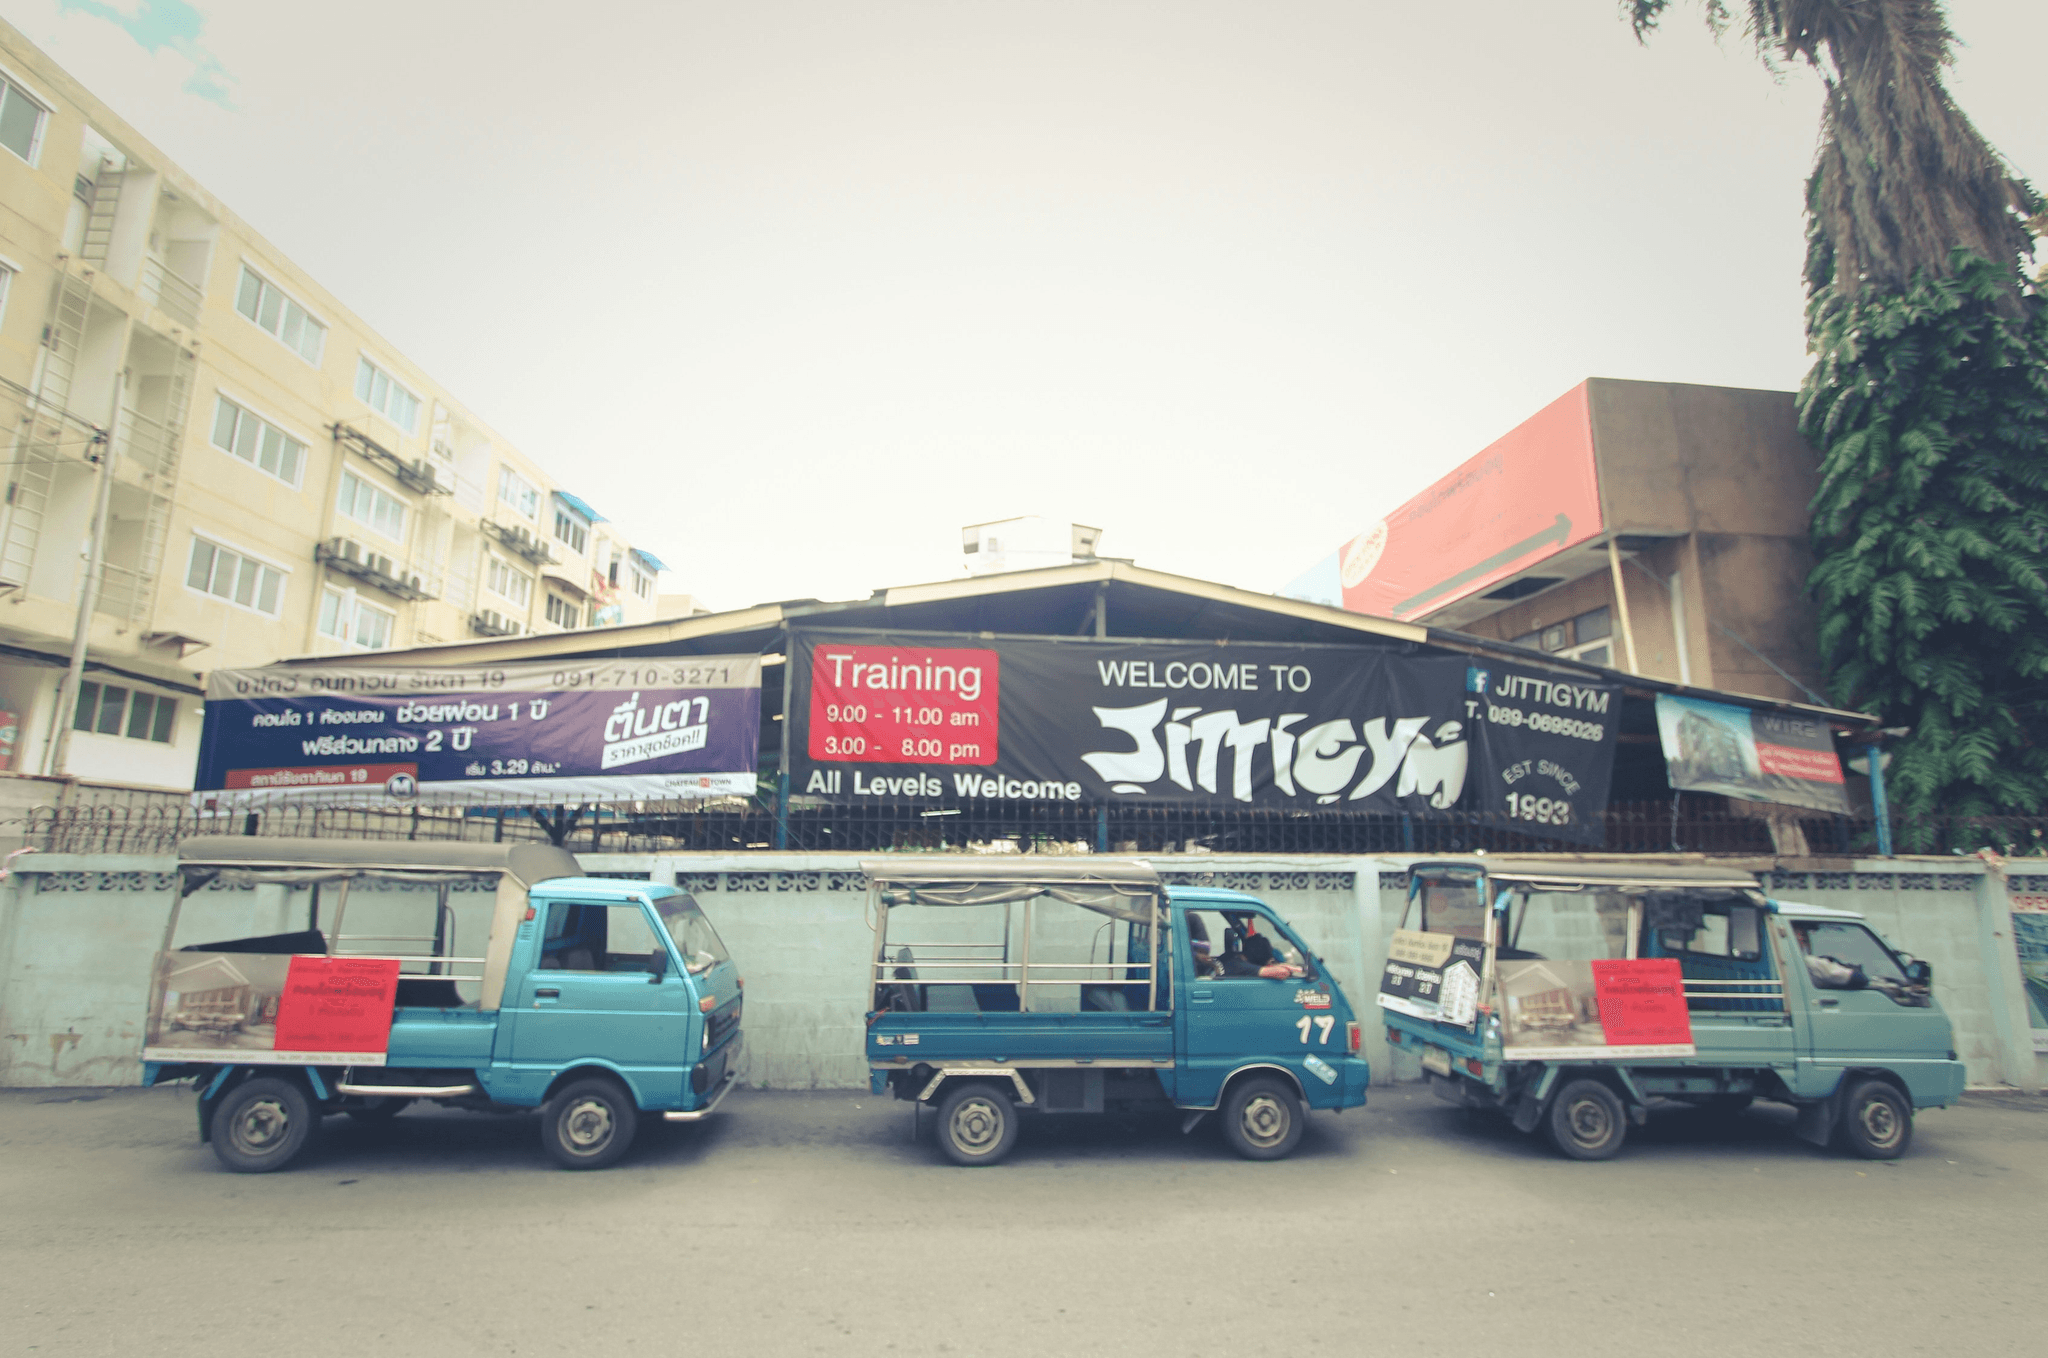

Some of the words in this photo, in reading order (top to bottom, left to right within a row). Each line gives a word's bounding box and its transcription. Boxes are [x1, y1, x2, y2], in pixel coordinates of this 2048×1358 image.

[479, 670, 505, 688] 19
[552, 668, 730, 686] 091-710-3271
[827, 653, 982, 700] Training
[1097, 659, 1259, 692] WELCOME
[1269, 665, 1312, 693] TO
[1495, 674, 1610, 714] JITTIGYM
[306, 711, 314, 726] 1
[396, 699, 499, 724] ช่วยผ่อน
[508, 702, 519, 721] 1
[603, 691, 710, 743] ตื่นตา
[827, 705, 867, 725] 9.00
[891, 707, 943, 727] 11.00
[950, 712, 980, 727] am
[1465, 700, 1482, 719] T.
[1488, 705, 1604, 742] 089-0695026
[425, 729, 444, 752] 2
[826, 736, 866, 755] 3.00
[902, 739, 943, 758] 8.00
[949, 742, 981, 762] pm
[491, 758, 529, 776] 3.29
[1502, 759, 1532, 785] EST
[1537, 759, 1581, 796] SINCE
[806, 770, 841, 795] All
[854, 772, 943, 798] Levels
[955, 775, 1082, 801] Welcome
[1295, 1014, 1335, 1045] 17
